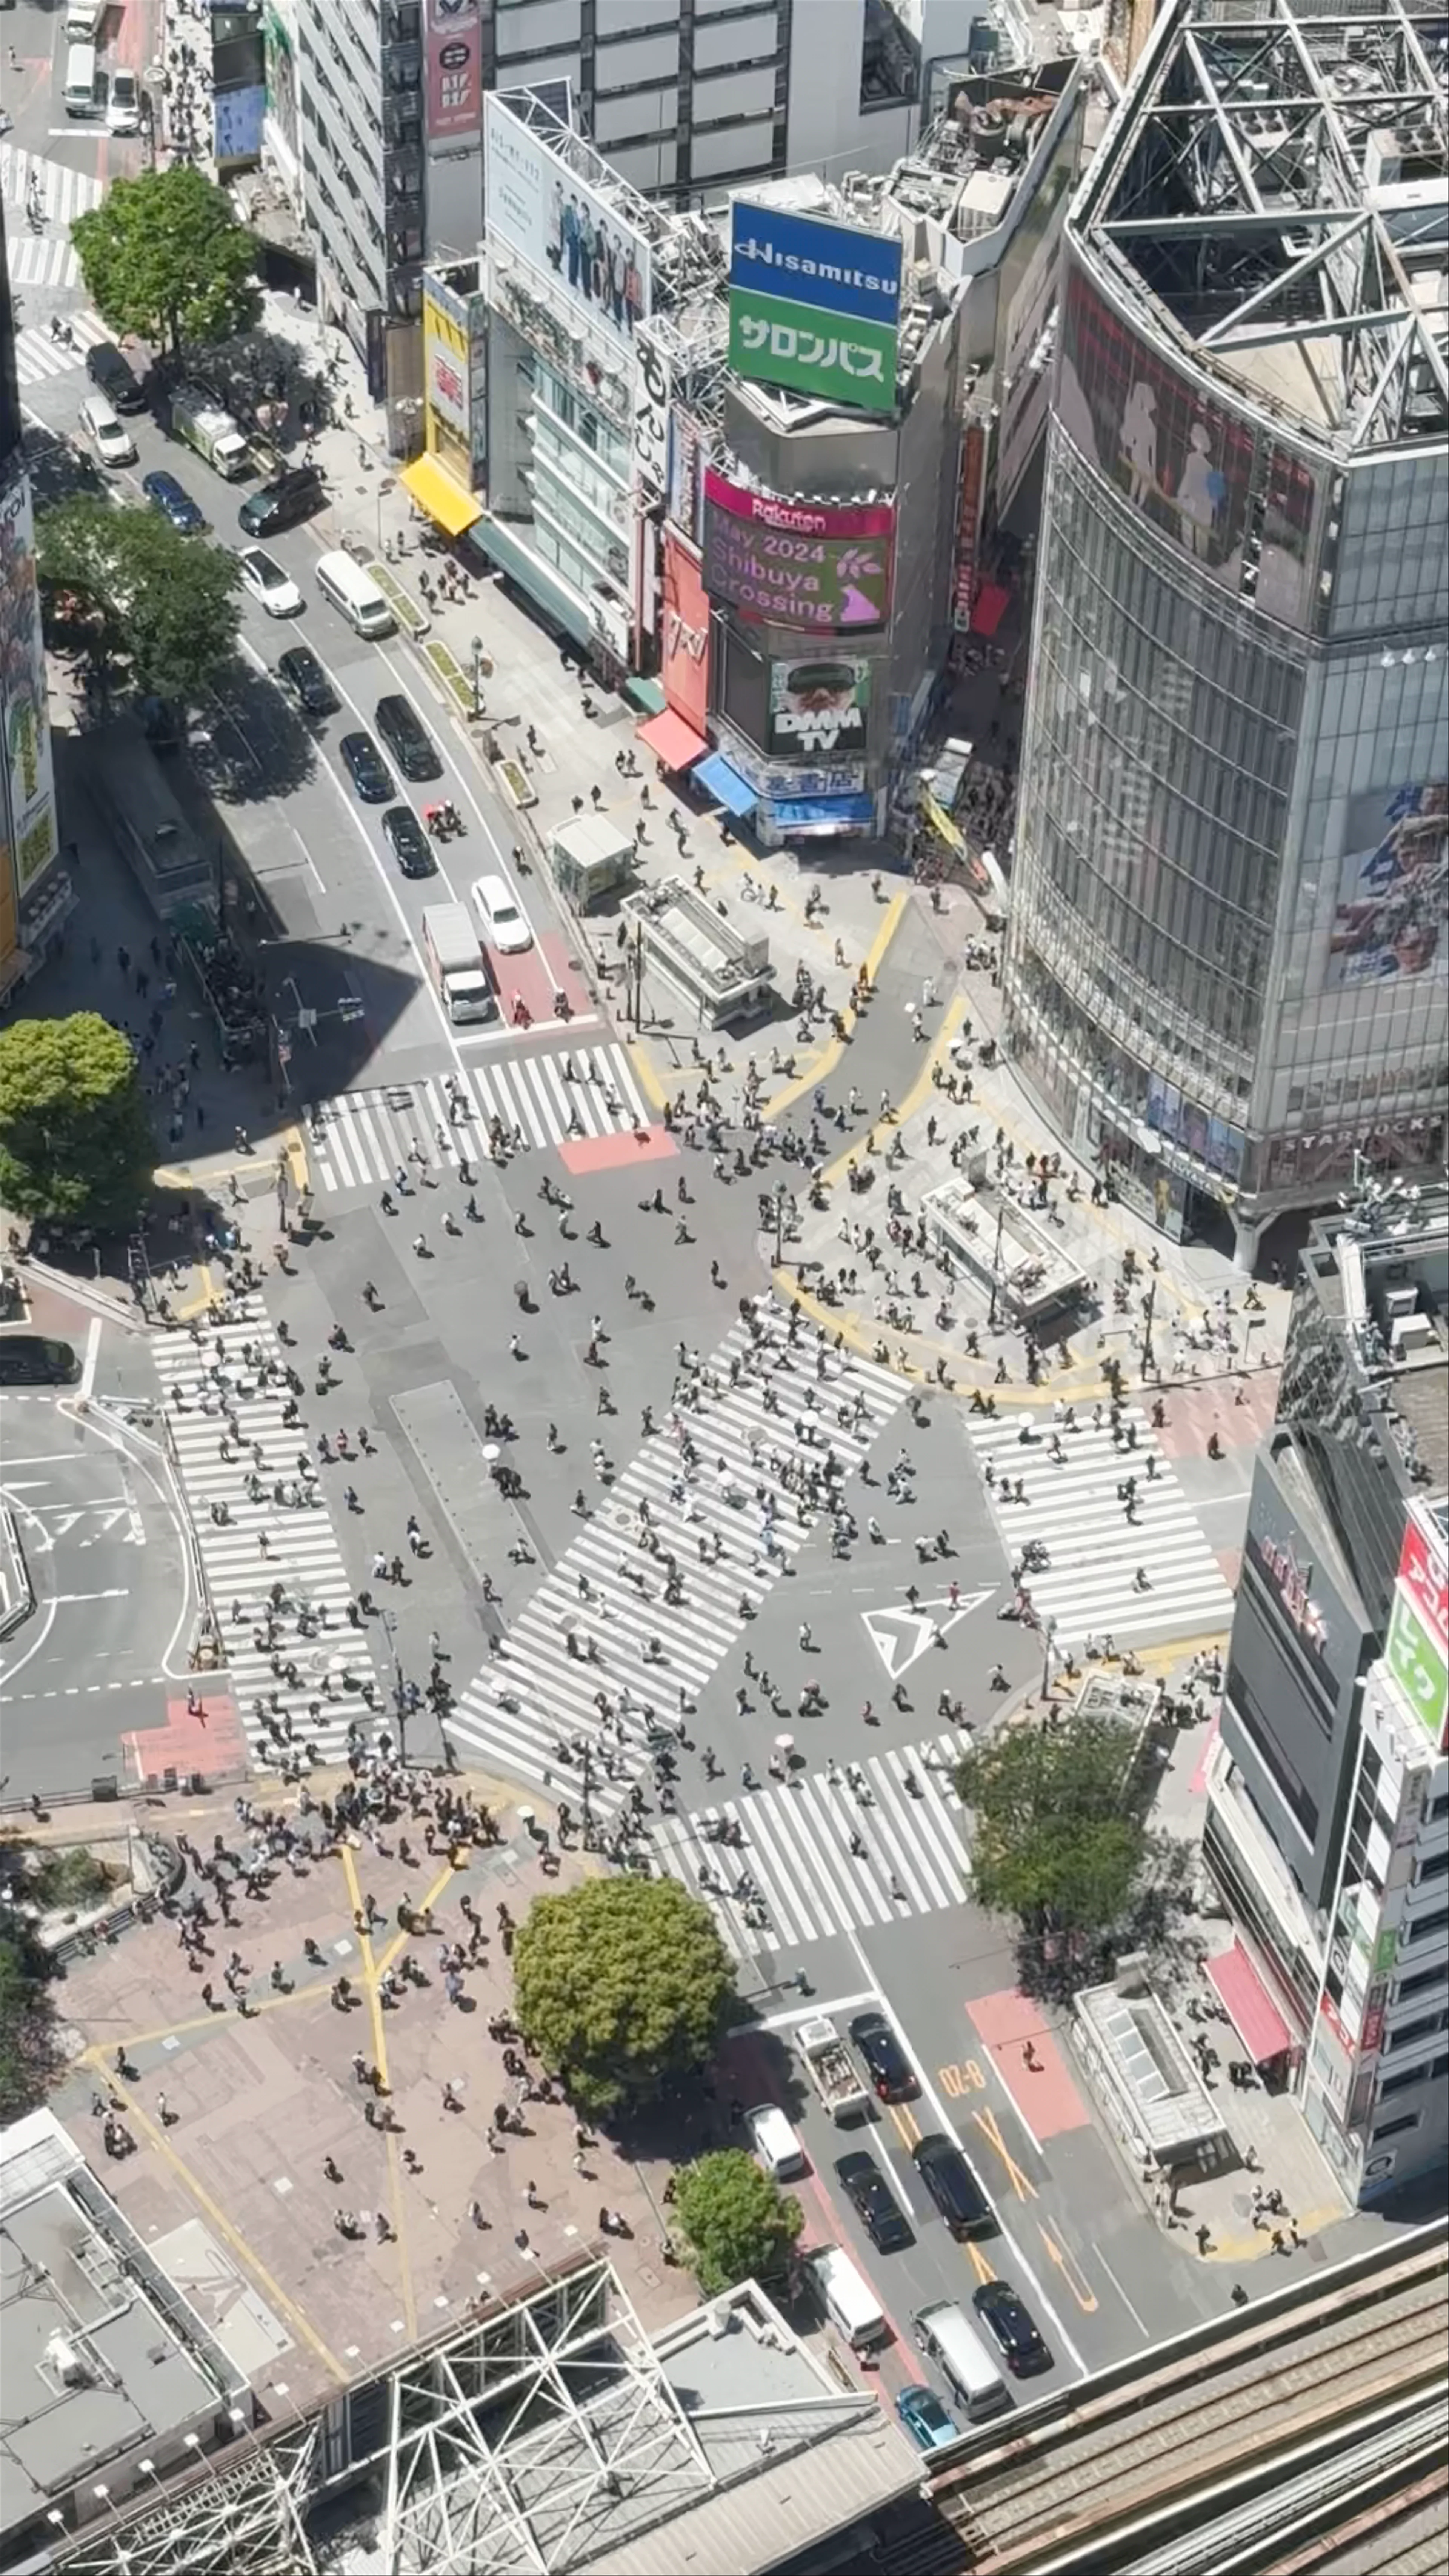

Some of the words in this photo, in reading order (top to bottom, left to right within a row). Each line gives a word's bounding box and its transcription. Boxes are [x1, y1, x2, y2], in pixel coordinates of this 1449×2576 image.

[734, 238, 897, 295] Hisamitsu
[738, 315, 884, 383] サロンパス
[713, 511, 754, 548] May
[763, 535, 826, 563] 2024
[752, 498, 826, 533] Rakuten
[712, 537, 820, 592] Shibuya
[711, 565, 834, 623] Crossing
[775, 708, 863, 734] DMM
[797, 729, 840, 751] TV
[1284, 1115, 1443, 1152] STARBUCKS
[938, 2059, 987, 2098] 8-20
